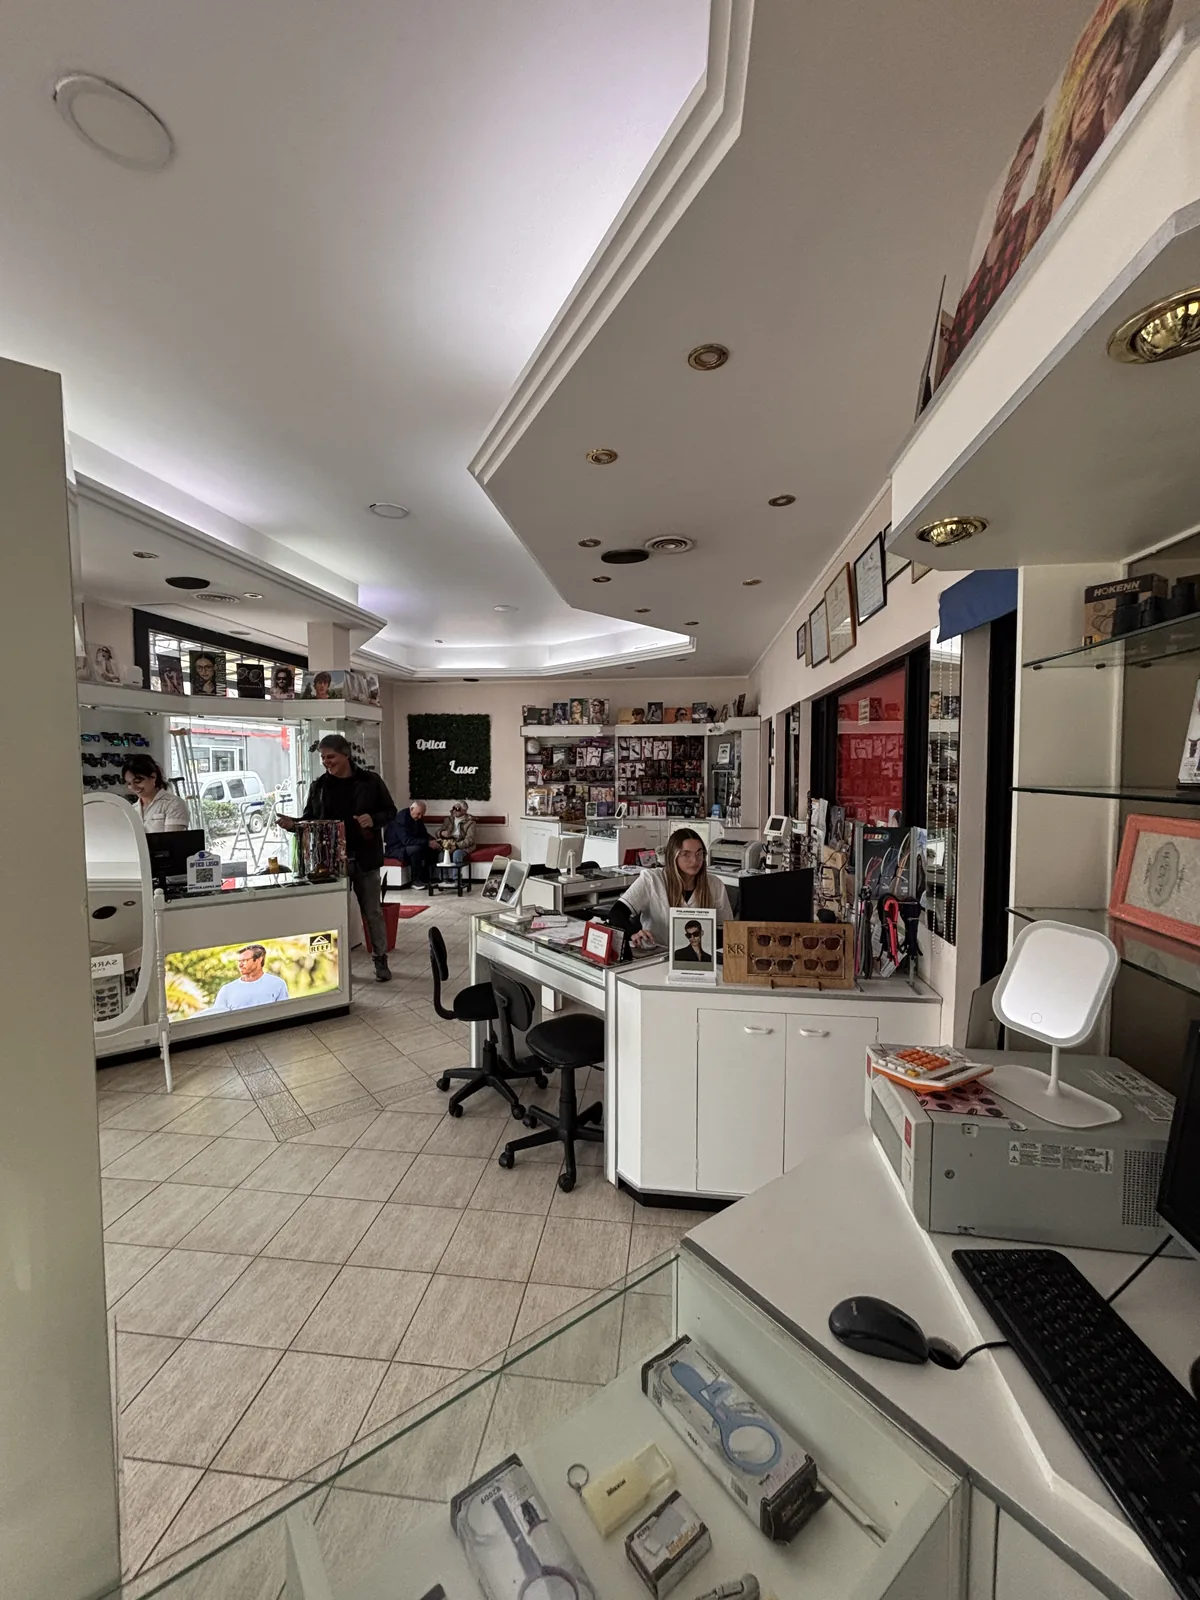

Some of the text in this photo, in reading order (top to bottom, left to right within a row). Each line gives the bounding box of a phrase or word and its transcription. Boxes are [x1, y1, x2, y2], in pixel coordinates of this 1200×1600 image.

[1093, 580, 1140, 597] HOKENN
[416, 739, 447, 751] Optica
[449, 760, 479, 774] Laser
[311, 944, 330, 952] REEF
[726, 943, 746, 956] KR
